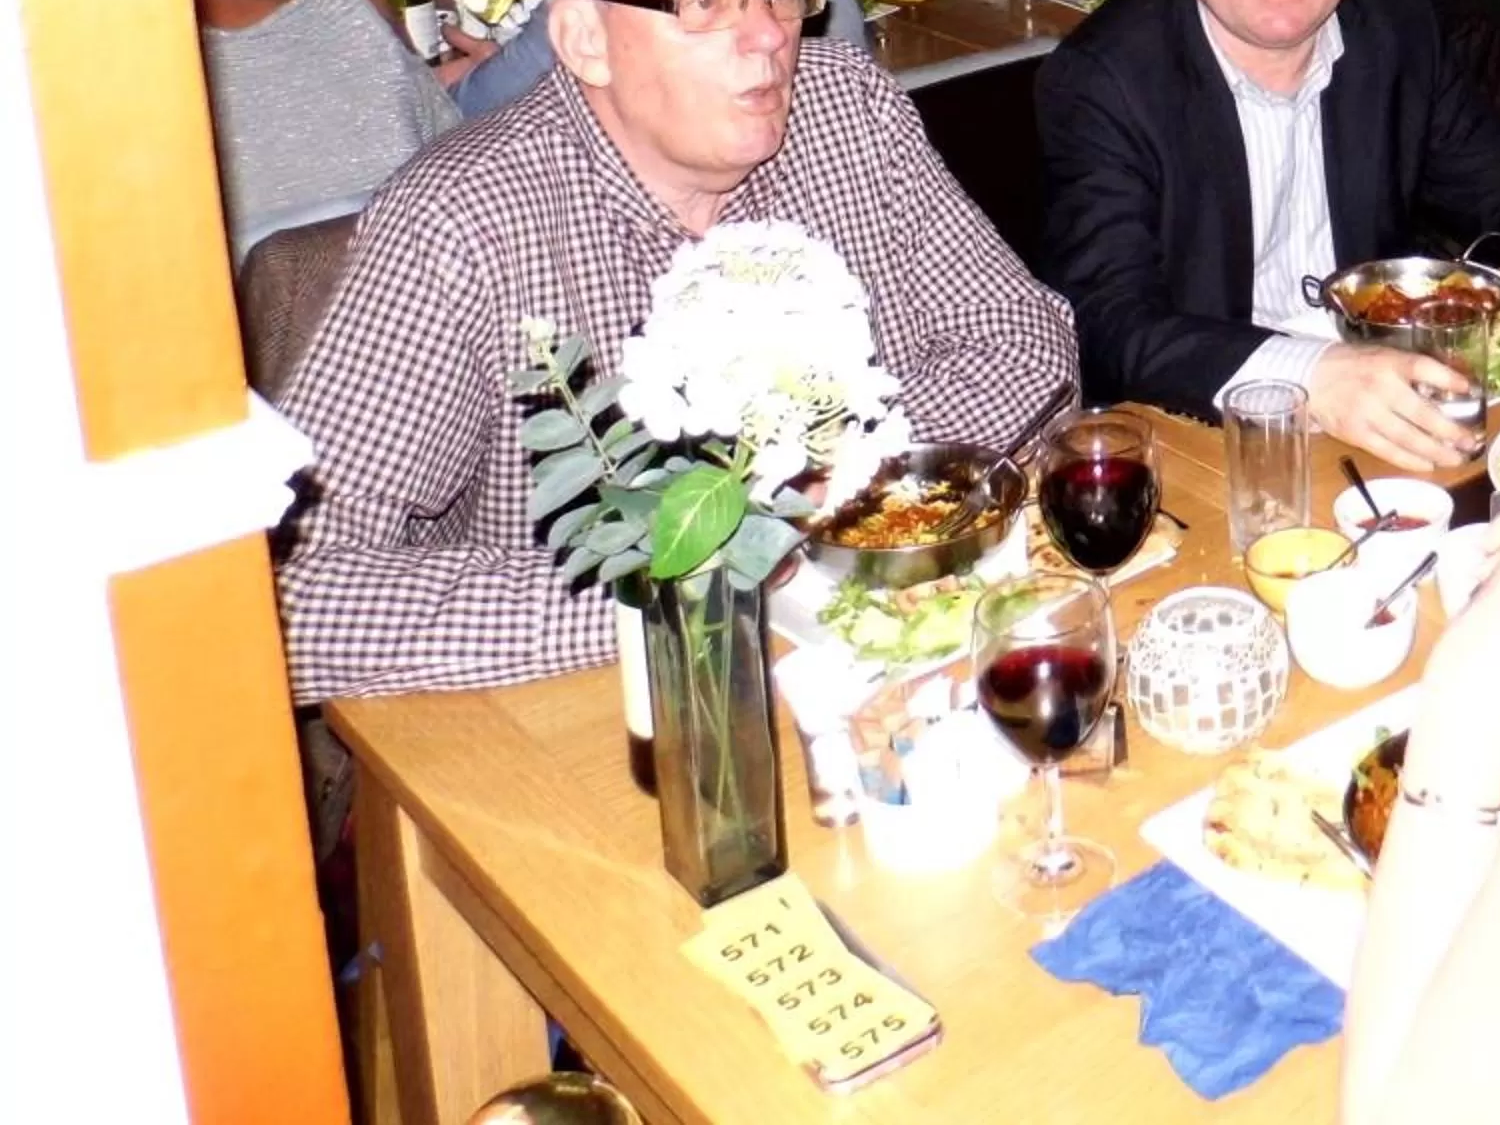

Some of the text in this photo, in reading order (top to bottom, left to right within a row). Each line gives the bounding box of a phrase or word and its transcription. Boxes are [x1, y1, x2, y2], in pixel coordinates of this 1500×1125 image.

[720, 922, 783, 962] 571
[745, 942, 814, 987] 572
[776, 967, 843, 1011] 573
[807, 991, 874, 1036] 574
[839, 1013, 906, 1059] 575
